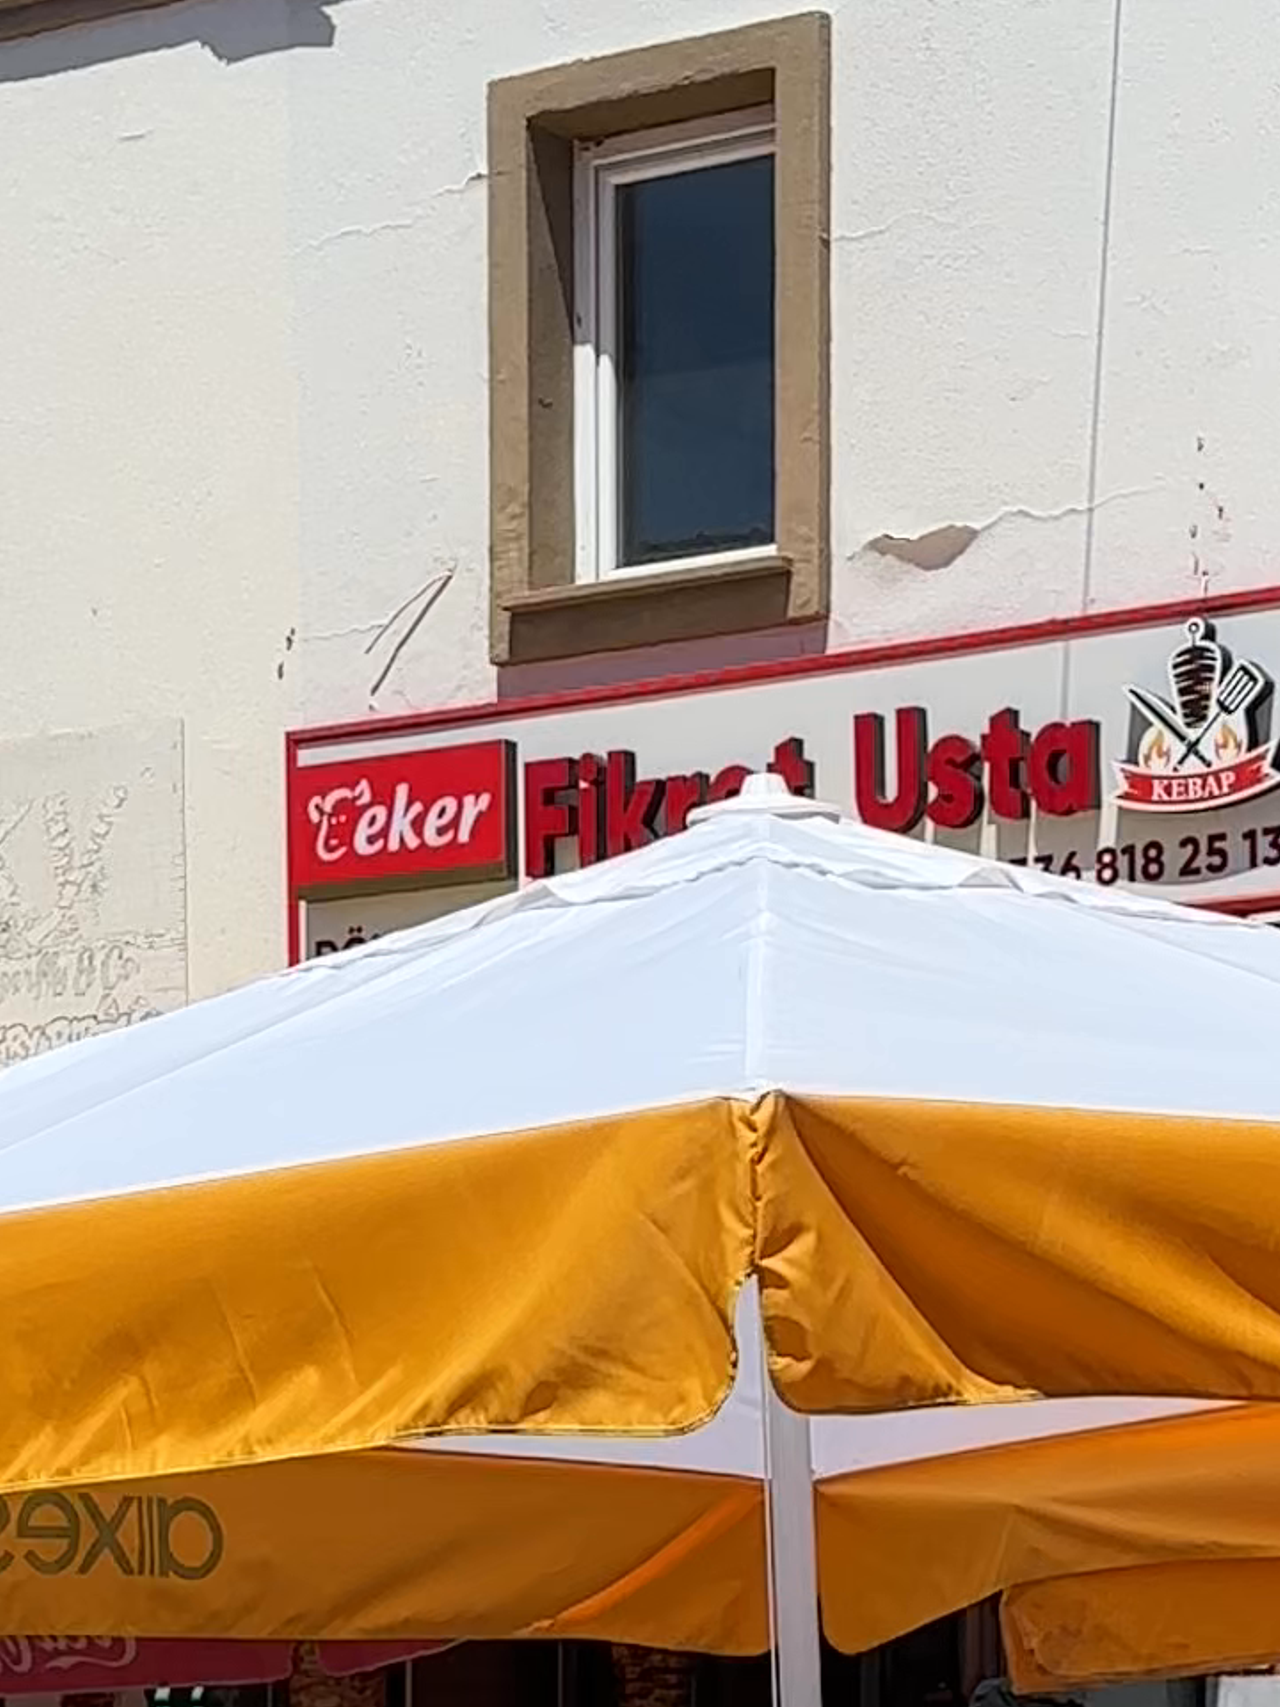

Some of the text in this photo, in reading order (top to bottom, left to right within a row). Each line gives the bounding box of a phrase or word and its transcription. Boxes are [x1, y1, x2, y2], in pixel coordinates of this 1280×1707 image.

[853, 705, 1100, 834] Usta
[1150, 769, 1237, 803] KEBAP
[1096, 839, 1165, 886] 818
[1179, 832, 1227, 878] 25
